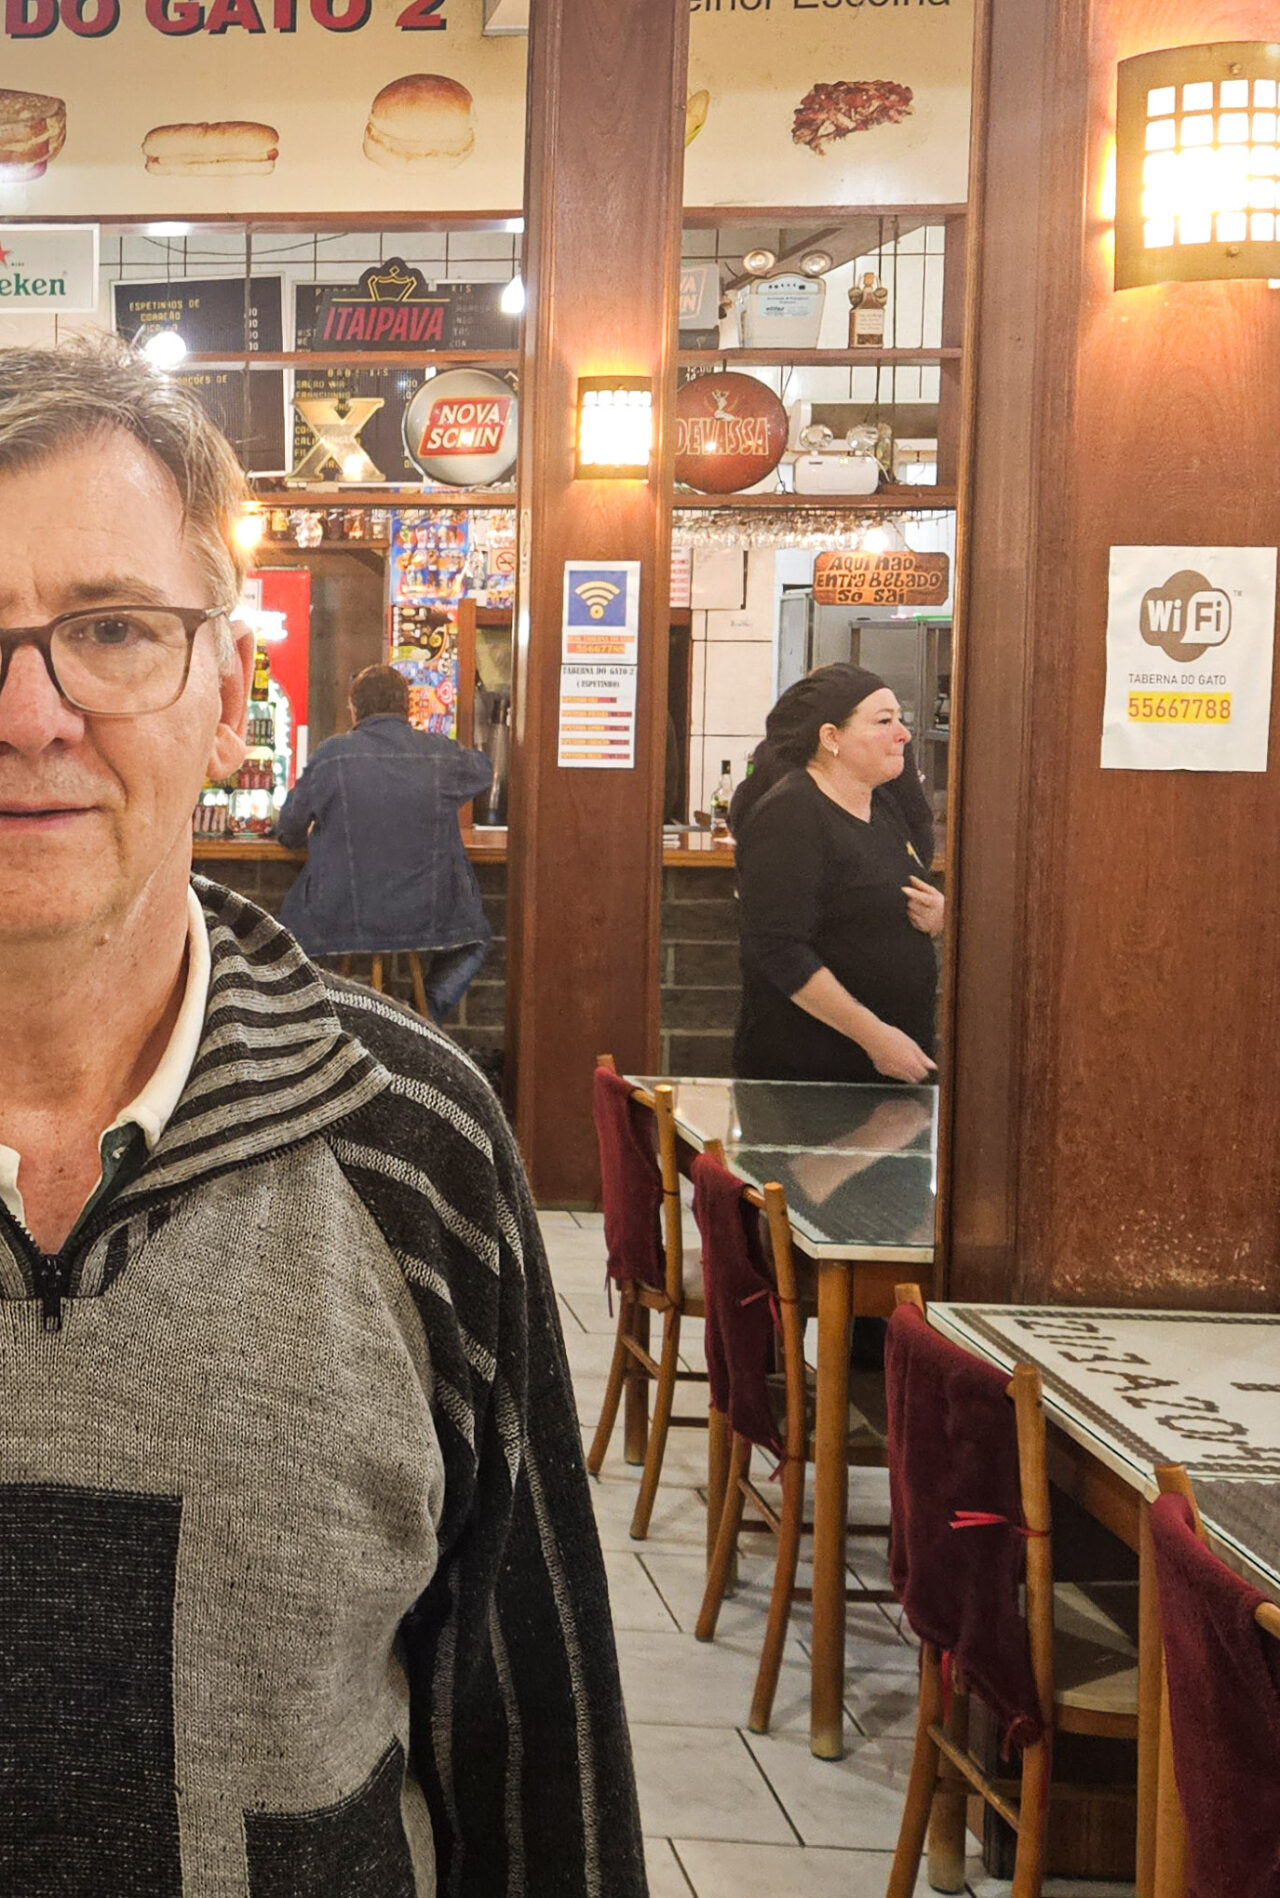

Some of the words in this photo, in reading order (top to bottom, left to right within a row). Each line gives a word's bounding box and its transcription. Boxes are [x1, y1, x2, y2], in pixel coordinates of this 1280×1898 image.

[5, 0, 120, 38] DO
[144, 0, 373, 36] GATO
[395, 0, 447, 31] 2
[323, 306, 445, 342] ITAIPAVA
[438, 403, 501, 424] NOVA
[427, 427, 500, 451] SCHIN
[676, 417, 770, 456] DEVASSA
[1128, 673, 1178, 686] TABERNA
[1180, 674, 1195, 686] DO
[1198, 674, 1227, 686] GATO
[1128, 697, 1232, 720] 55667788
